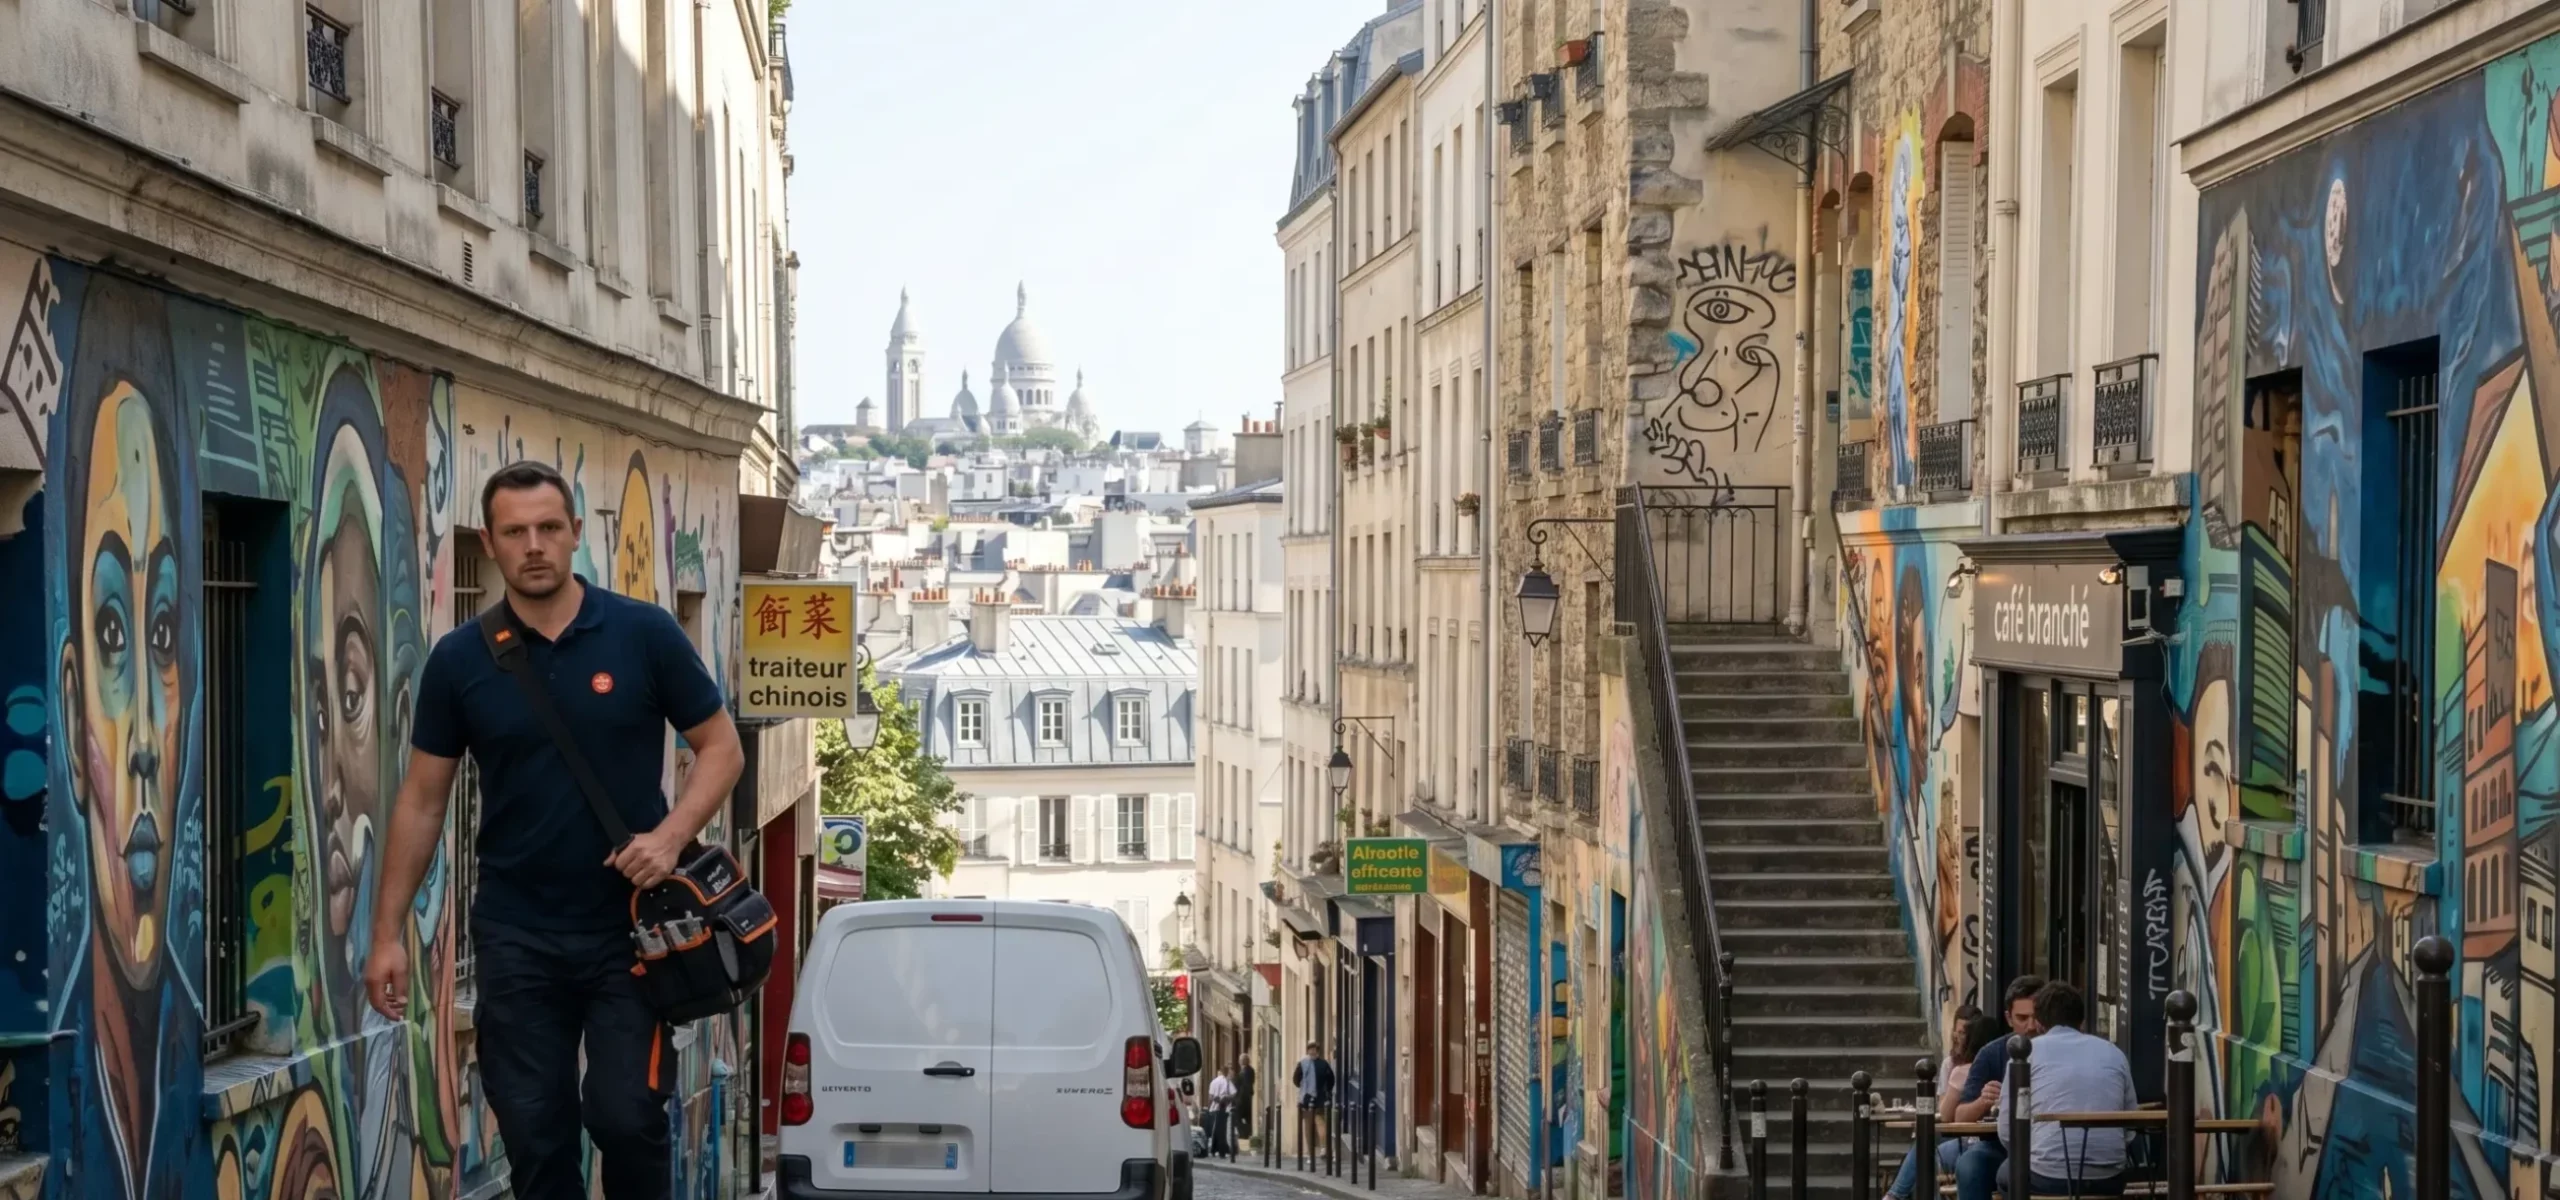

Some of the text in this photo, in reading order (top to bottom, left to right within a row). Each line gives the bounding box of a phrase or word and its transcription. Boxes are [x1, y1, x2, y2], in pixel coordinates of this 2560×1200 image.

[1994, 583, 2090, 649] café branché
[749, 656, 847, 678] traiteur
[749, 685, 847, 708] chinois
